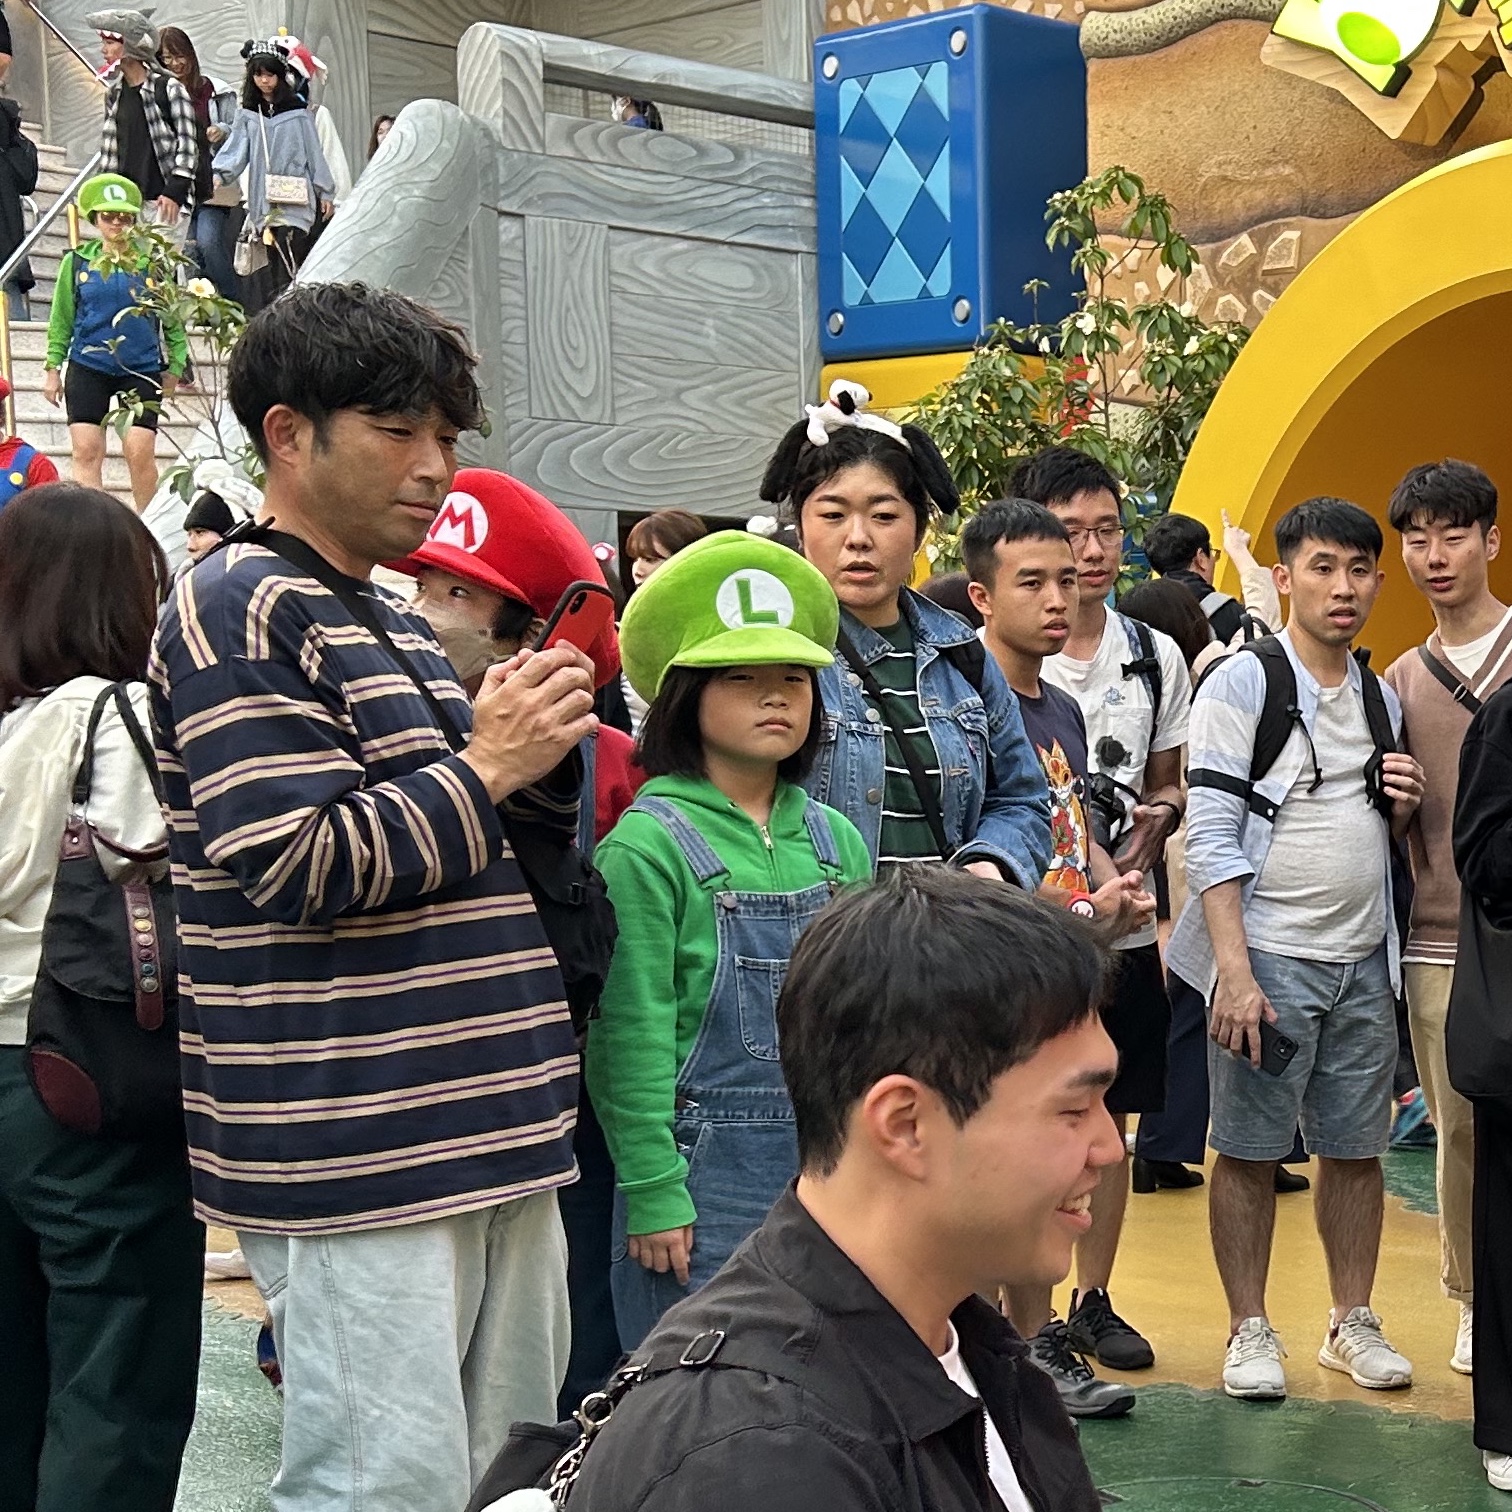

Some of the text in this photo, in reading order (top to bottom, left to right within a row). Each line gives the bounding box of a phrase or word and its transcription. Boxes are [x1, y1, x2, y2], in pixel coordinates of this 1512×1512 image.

[110, 187, 122, 200] L
[429, 501, 476, 549] M
[735, 578, 779, 624] L
